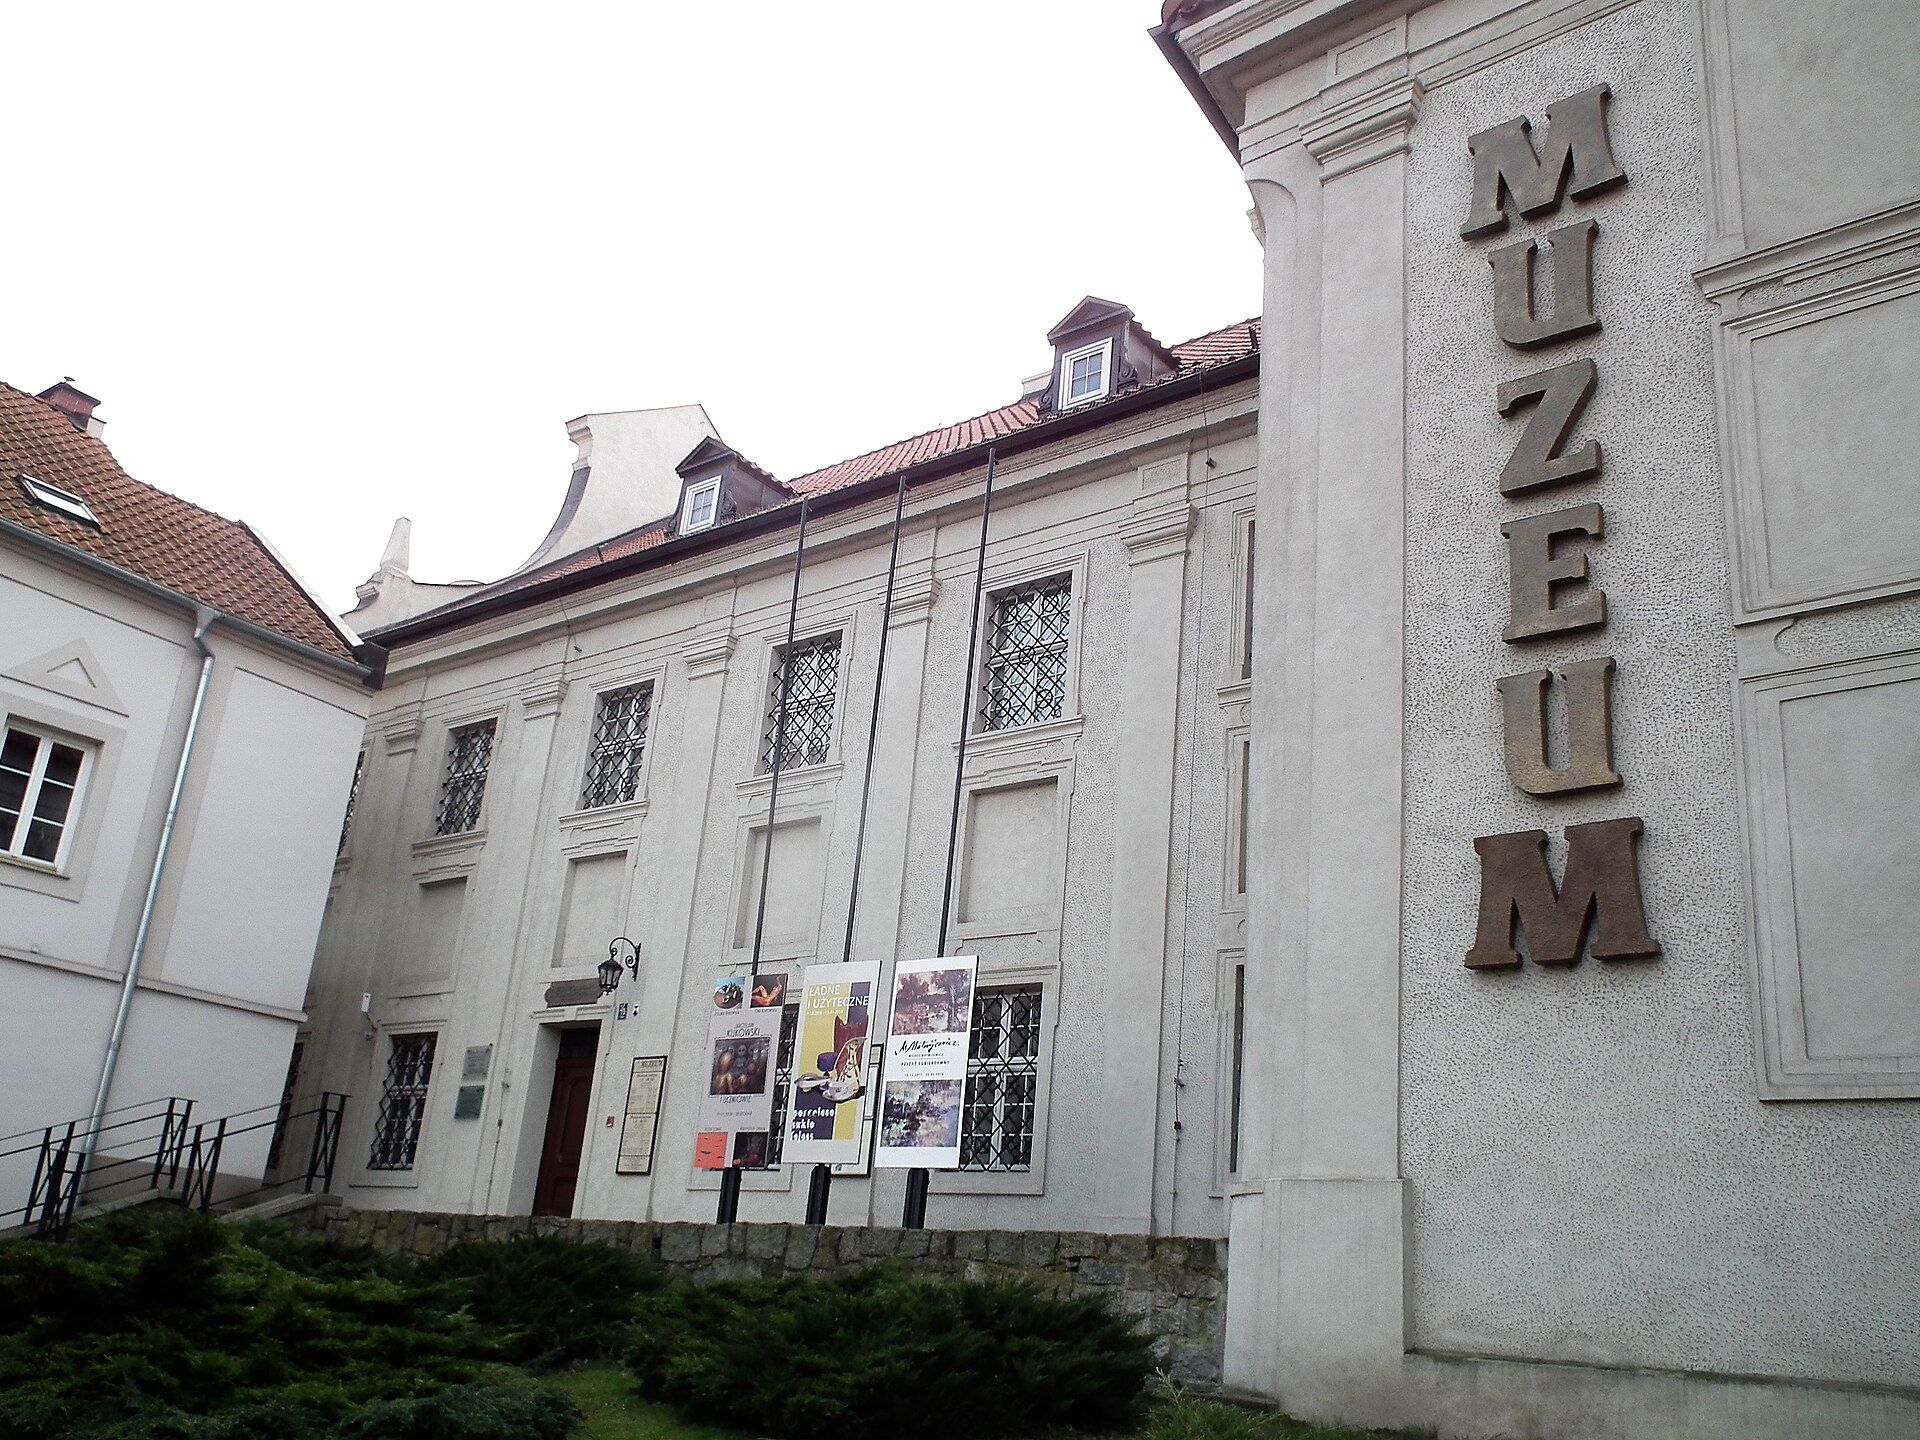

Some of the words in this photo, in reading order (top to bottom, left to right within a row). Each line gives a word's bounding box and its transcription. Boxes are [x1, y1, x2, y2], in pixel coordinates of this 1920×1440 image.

[1461, 82, 1662, 971] MUZEUM
[809, 984, 841, 997] ŁADNE
[807, 999, 811, 1009] I
[813, 995, 870, 1009] UŻYTECZNE
[726, 1028, 760, 1037] KUKOWSKI
